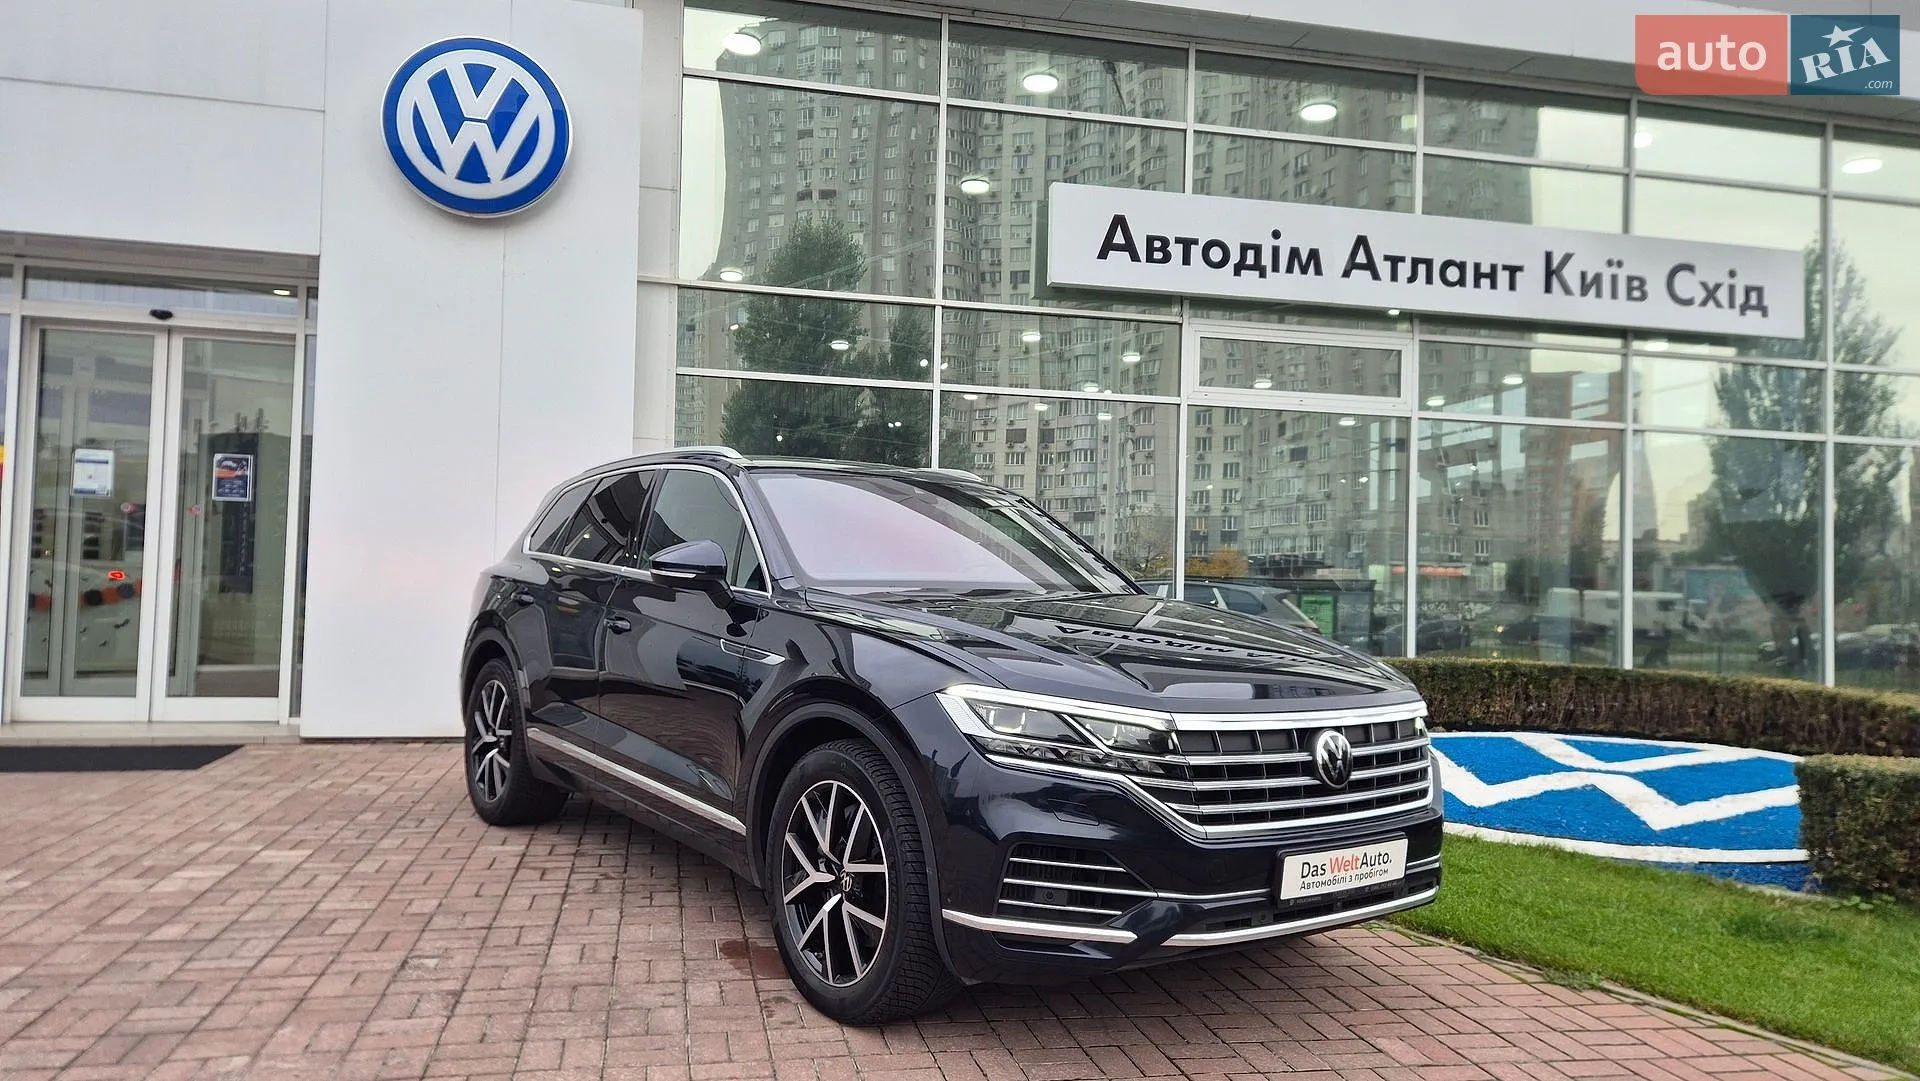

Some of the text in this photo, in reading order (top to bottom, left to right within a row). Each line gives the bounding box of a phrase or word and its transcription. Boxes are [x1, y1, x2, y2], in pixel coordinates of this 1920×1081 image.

[1096, 213, 1769, 318] Автодім Атлант Київ Схід
[1299, 867, 1389, 891] Автомобілі з пробігом
[1300, 861, 1327, 879] Das
